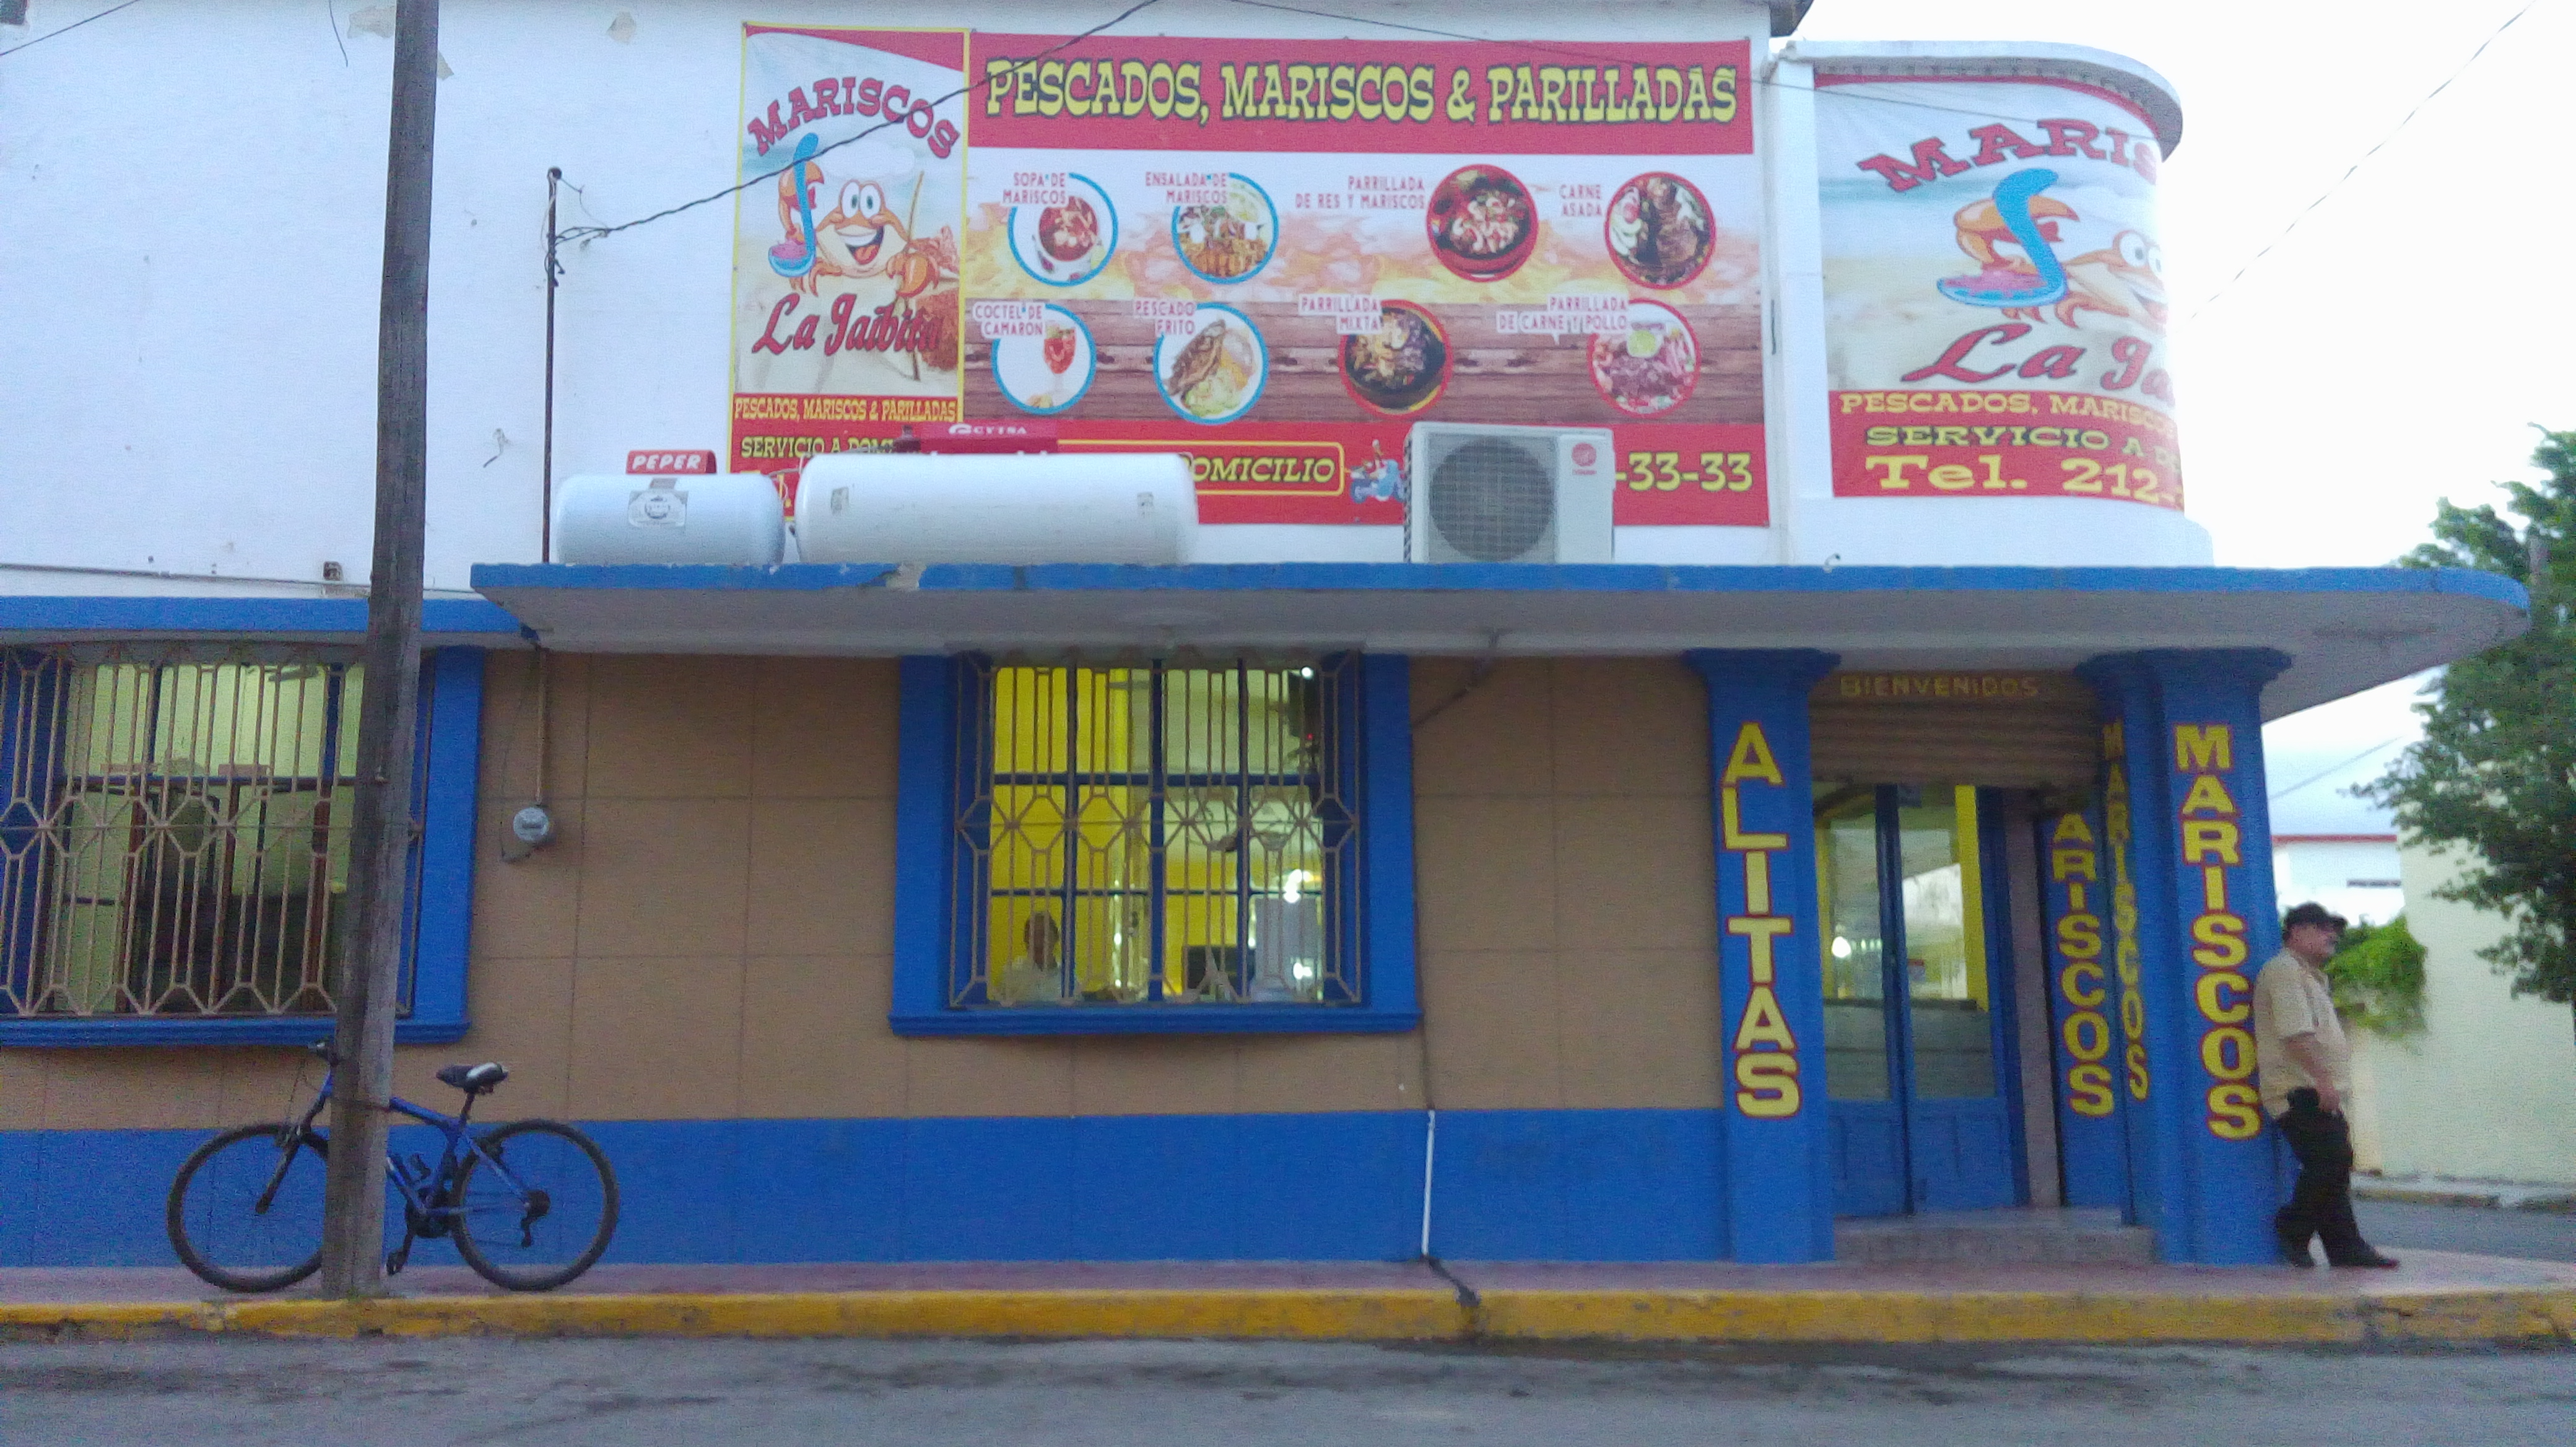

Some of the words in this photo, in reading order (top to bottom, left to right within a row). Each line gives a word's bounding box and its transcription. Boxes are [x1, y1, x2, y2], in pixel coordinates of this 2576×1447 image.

[986, 58, 1209, 126] PESCADOS,
[1222, 61, 1435, 122] MARISCOS
[1447, 68, 1476, 123] &
[1487, 64, 1737, 123] PARILLADAS
[747, 76, 960, 159] MARISCOS
[1013, 172, 1045, 186] SOPA
[1052, 172, 1066, 186] DE
[1146, 172, 1208, 186] ENSALADA
[1212, 172, 1227, 186] DE
[1348, 175, 1425, 190] PARRILLADA
[1003, 190, 1066, 204] MARISCOS
[1166, 190, 1227, 204] MARISCOS
[1559, 184, 1603, 199] CARNE
[1295, 193, 1311, 208] DE
[1317, 193, 1341, 208] RES
[1347, 193, 1354, 208] Y
[1360, 193, 1425, 209] MARISCOS
[1561, 202, 1603, 217] ASADA
[975, 304, 1022, 319] COCTEL
[1028, 304, 1042, 319] DE
[1136, 300, 1196, 316] PESCADO
[1301, 297, 1379, 311] PARRILLADA
[1549, 297, 1627, 311] PARRILLADA
[751, 292, 821, 356] La
[1157, 319, 1195, 335] FRITO
[1339, 316, 1380, 330] MIXTA
[1498, 315, 1516, 330] DE
[1521, 315, 1566, 330] CARNE
[1570, 315, 1578, 330] Y
[1586, 315, 1628, 330] POLLO
[1900, 322, 2087, 384] La
[803, 397, 868, 421] MARISCOS
[881, 398, 957, 422] PARILLADAS
[741, 435, 825, 458] SERVICIO
[830, 436, 842, 453] A
[1865, 426, 2110, 450] SERVICIO
[2120, 435, 2146, 457] A
[632, 454, 702, 470] PEPER
[1183, 456, 1336, 484] OMICILIO
[1865, 454, 2028, 491] Tel.
[1840, 675, 2039, 697] BIENVENIDOS
[2102, 717, 2151, 1102] MARISCOS
[1720, 721, 1802, 1118] ALITAS
[2172, 722, 2264, 1140] MARISCOS
[2051, 812, 2115, 1117] ARISCOS
